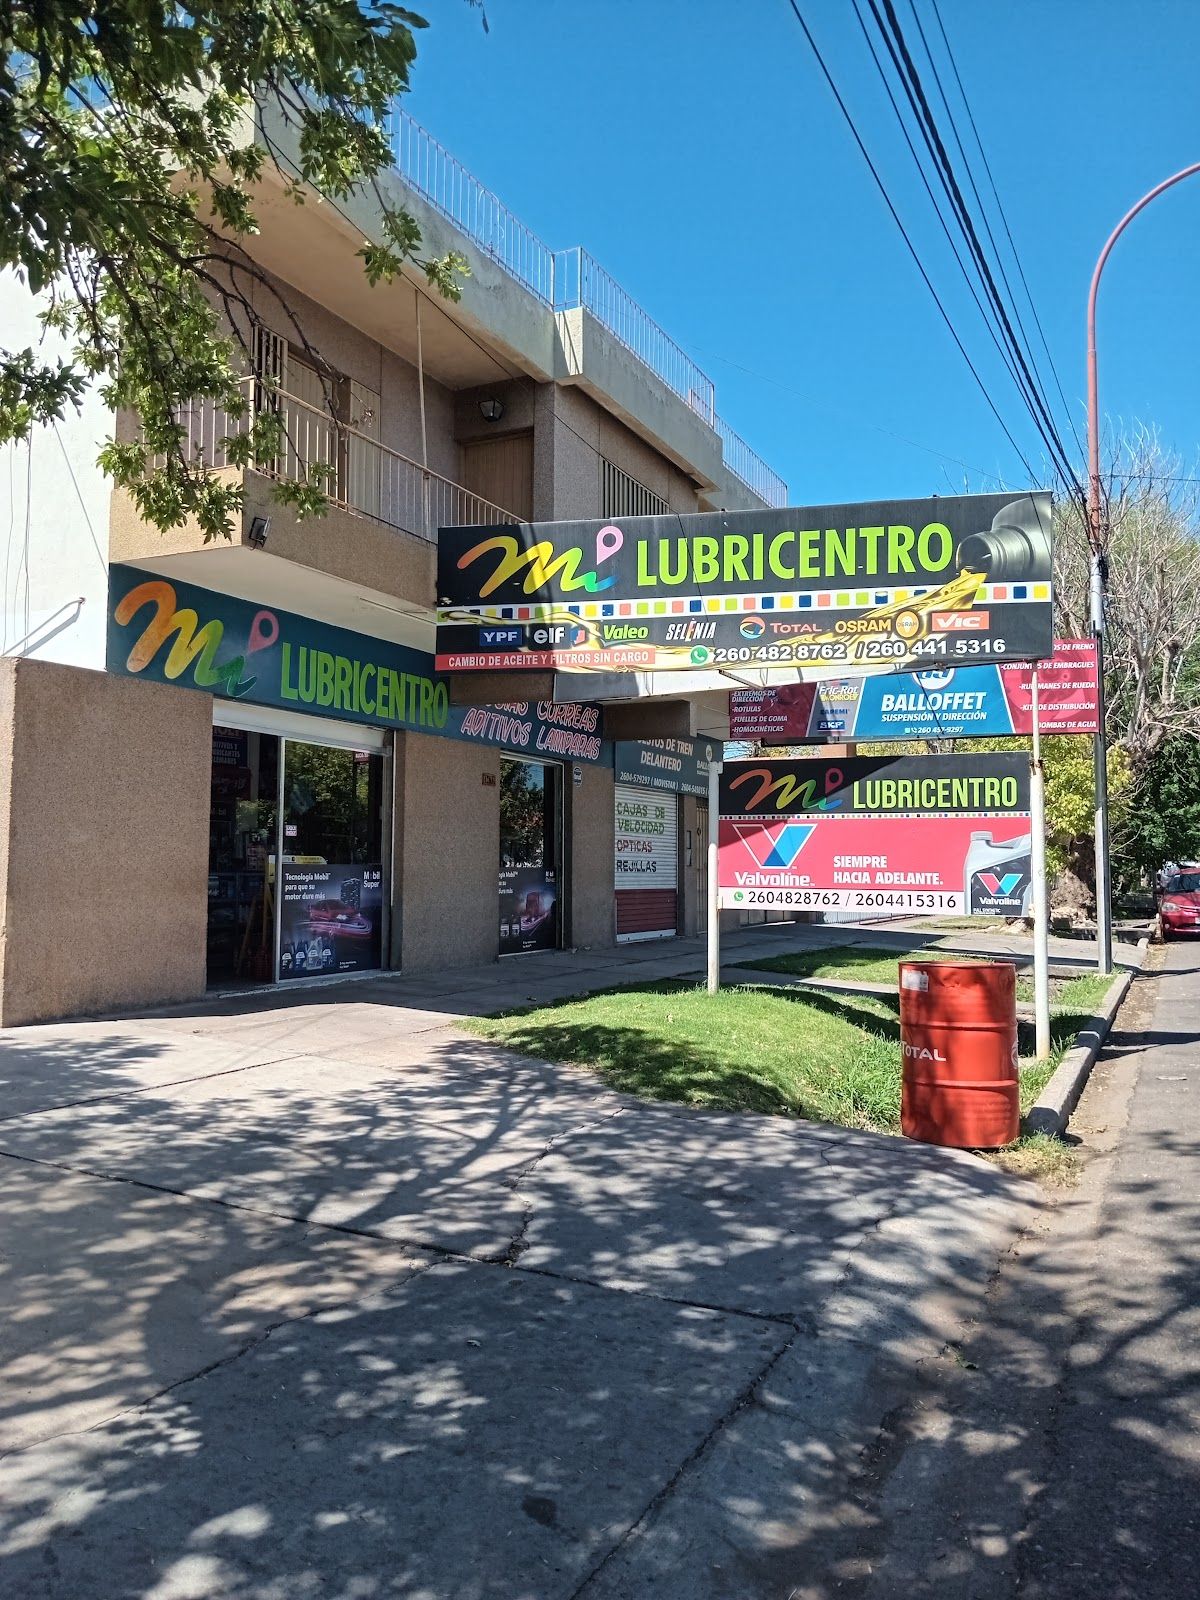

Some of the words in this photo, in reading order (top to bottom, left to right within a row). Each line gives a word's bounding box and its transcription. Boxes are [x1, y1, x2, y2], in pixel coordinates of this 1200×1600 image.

[637, 522, 954, 587] LUBRICENTRO
[603, 624, 649, 640] Valeo
[835, 618, 892, 634] OSRAM
[484, 631, 518, 642] YPF
[533, 626, 565, 644] elf
[715, 647, 751, 662] 260
[797, 643, 846, 659] 8762
[868, 642, 906, 657] 260
[955, 638, 1006, 654] 5316
[449, 655, 486, 667] CAMBIO
[489, 655, 501, 666] DE
[504, 654, 538, 666] ACEITE
[541, 654, 548, 664] Y
[551, 653, 591, 664] FILTROS
[594, 652, 611, 663] SIN
[614, 651, 649, 663] CARGO
[1053, 661, 1095, 669] EMBRAGUES
[281, 642, 449, 729] LUBRICENTRO
[881, 691, 987, 712] BALLOFFET
[881, 711, 934, 722] SUSPENSIÓN
[942, 710, 988, 720] DIRECCIÓN
[461, 707, 532, 746] ADITIVOS
[820, 721, 843, 729] SKF
[665, 739, 676, 752] DE
[677, 740, 694, 757] TREN
[640, 750, 682, 772] DELANTERO
[853, 776, 1018, 809] LUBRICENTRO
[616, 801, 648, 817] CAJAS
[655, 806, 666, 819] DE
[618, 819, 665, 835] VELOCIDAD
[616, 839, 653, 853] OPTICAS
[616, 860, 657, 873] REJILLAS
[833, 855, 888, 868] SIEMPRE
[363, 880, 380, 890] Super
[734, 871, 811, 886] Valvoline
[833, 871, 871, 884] HACIA
[875, 873, 944, 885] ADELANTE.
[285, 884, 297, 892] para
[298, 884, 308, 892] que
[302, 892, 314, 900] dure
[748, 890, 841, 906] 2604828762
[855, 893, 957, 908] 2604415316
[901, 1040, 947, 1062] TOTAL
